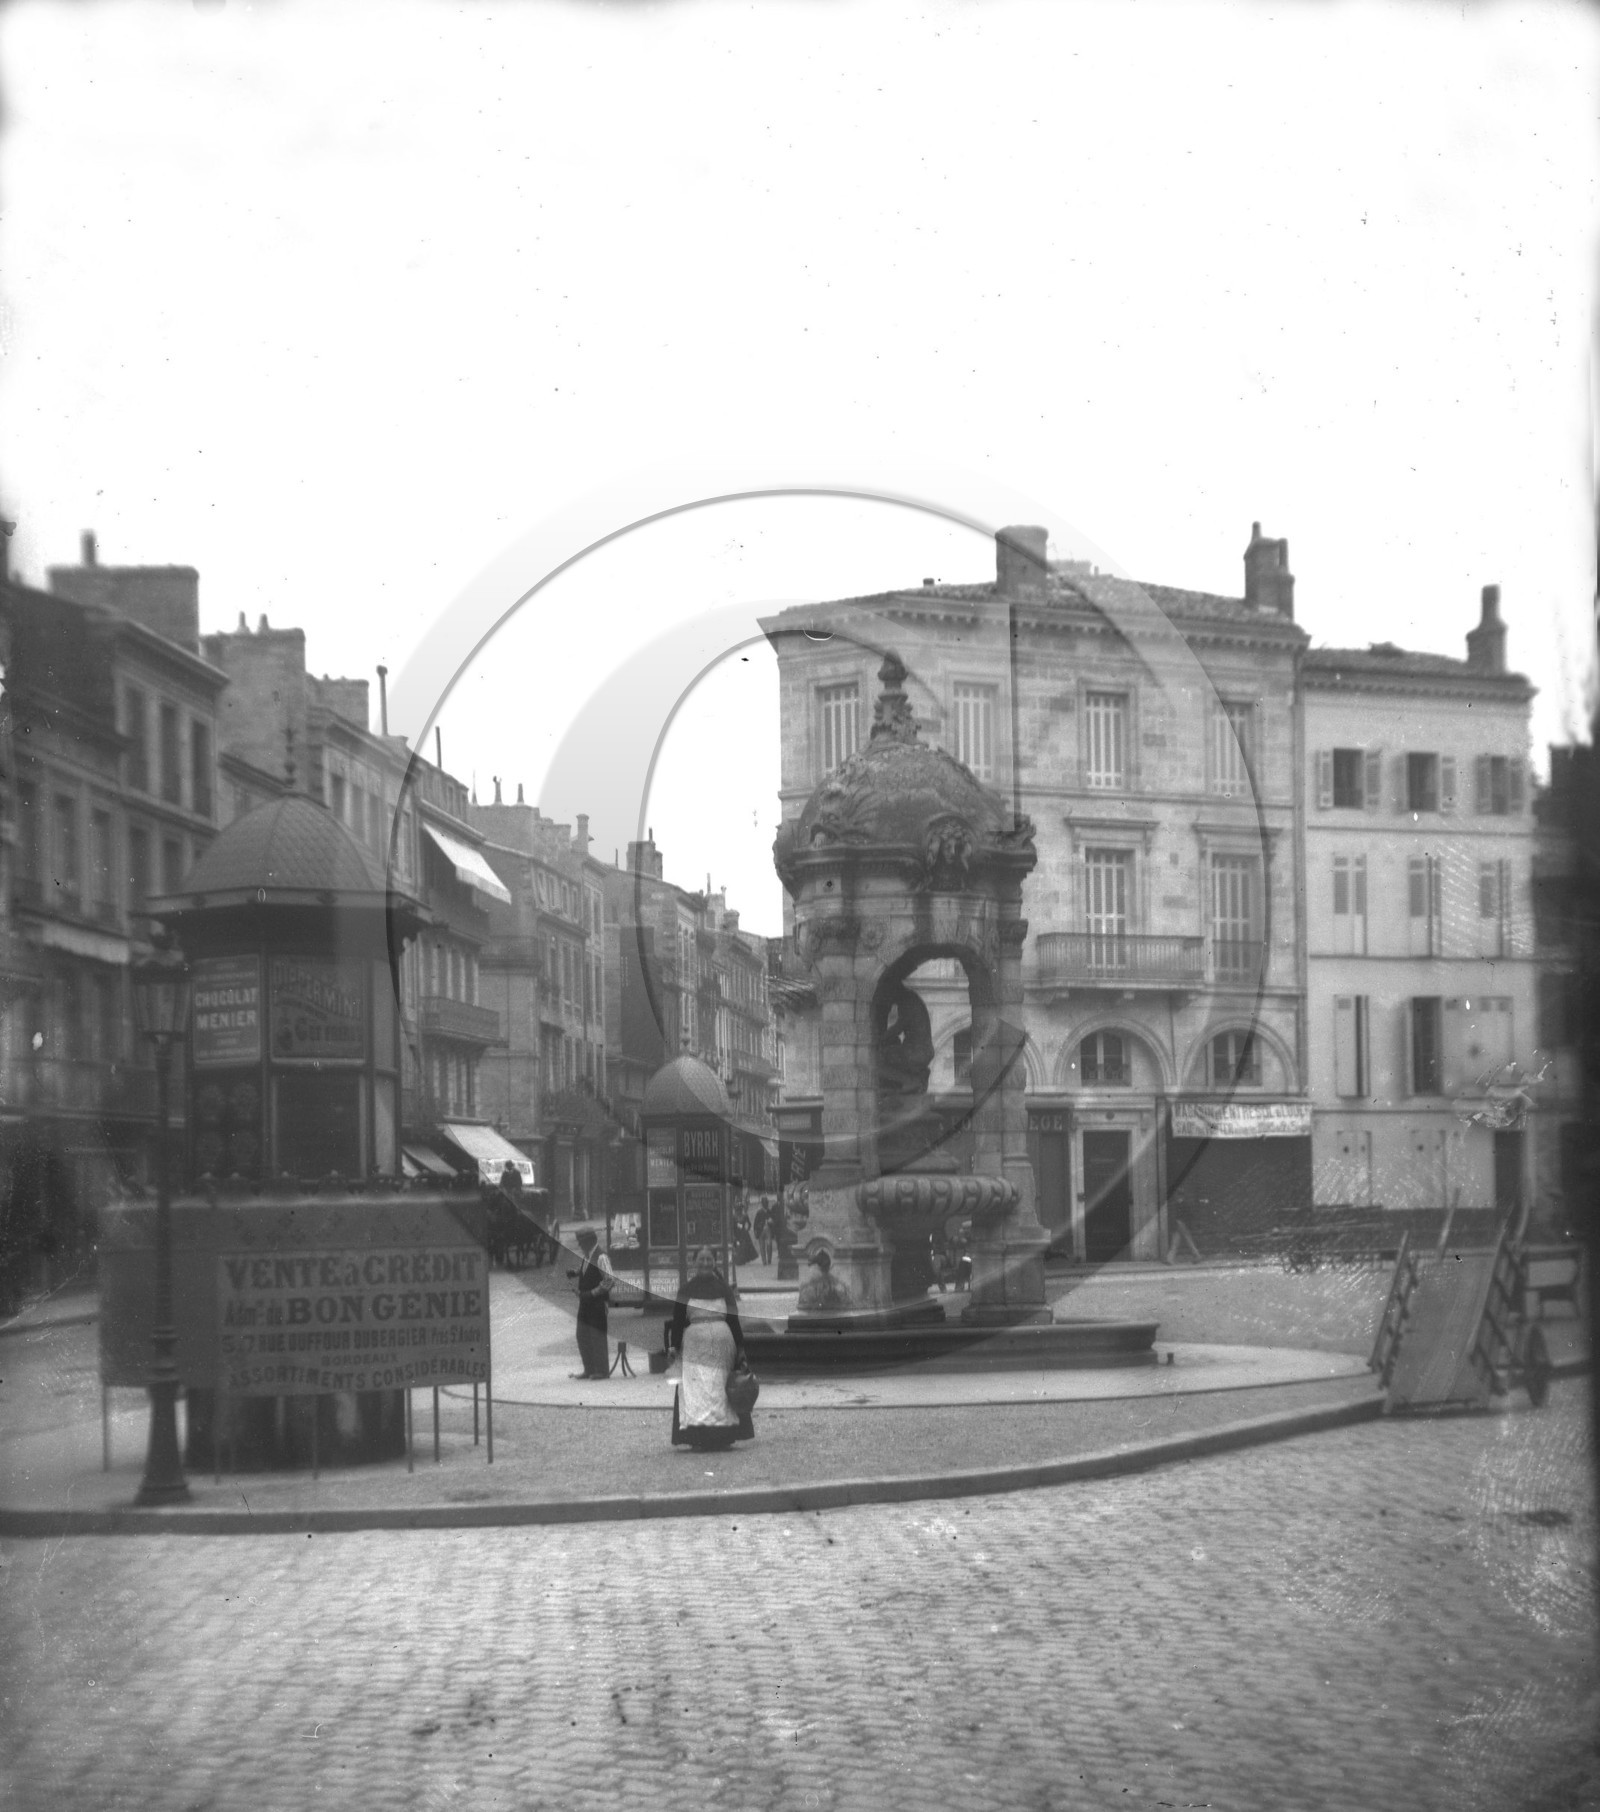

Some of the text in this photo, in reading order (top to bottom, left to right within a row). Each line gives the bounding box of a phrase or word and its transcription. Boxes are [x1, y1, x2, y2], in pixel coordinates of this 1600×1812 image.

[195, 987, 258, 1008] CHOCOLAT
[196, 1009, 257, 1031] MENIER
[684, 1130, 719, 1158] BYRRH
[225, 1257, 341, 1290] VENTE
[287, 1296, 366, 1325] BON
[373, 1290, 482, 1321] GÉNIE
[259, 1333, 286, 1353] RUE
[289, 1330, 350, 1352] DUFFOUR
[355, 1327, 427, 1349] DUBERGIER
[321, 1353, 399, 1367] BORDEAUX
[230, 1364, 366, 1390] ASSORTIMENTS
